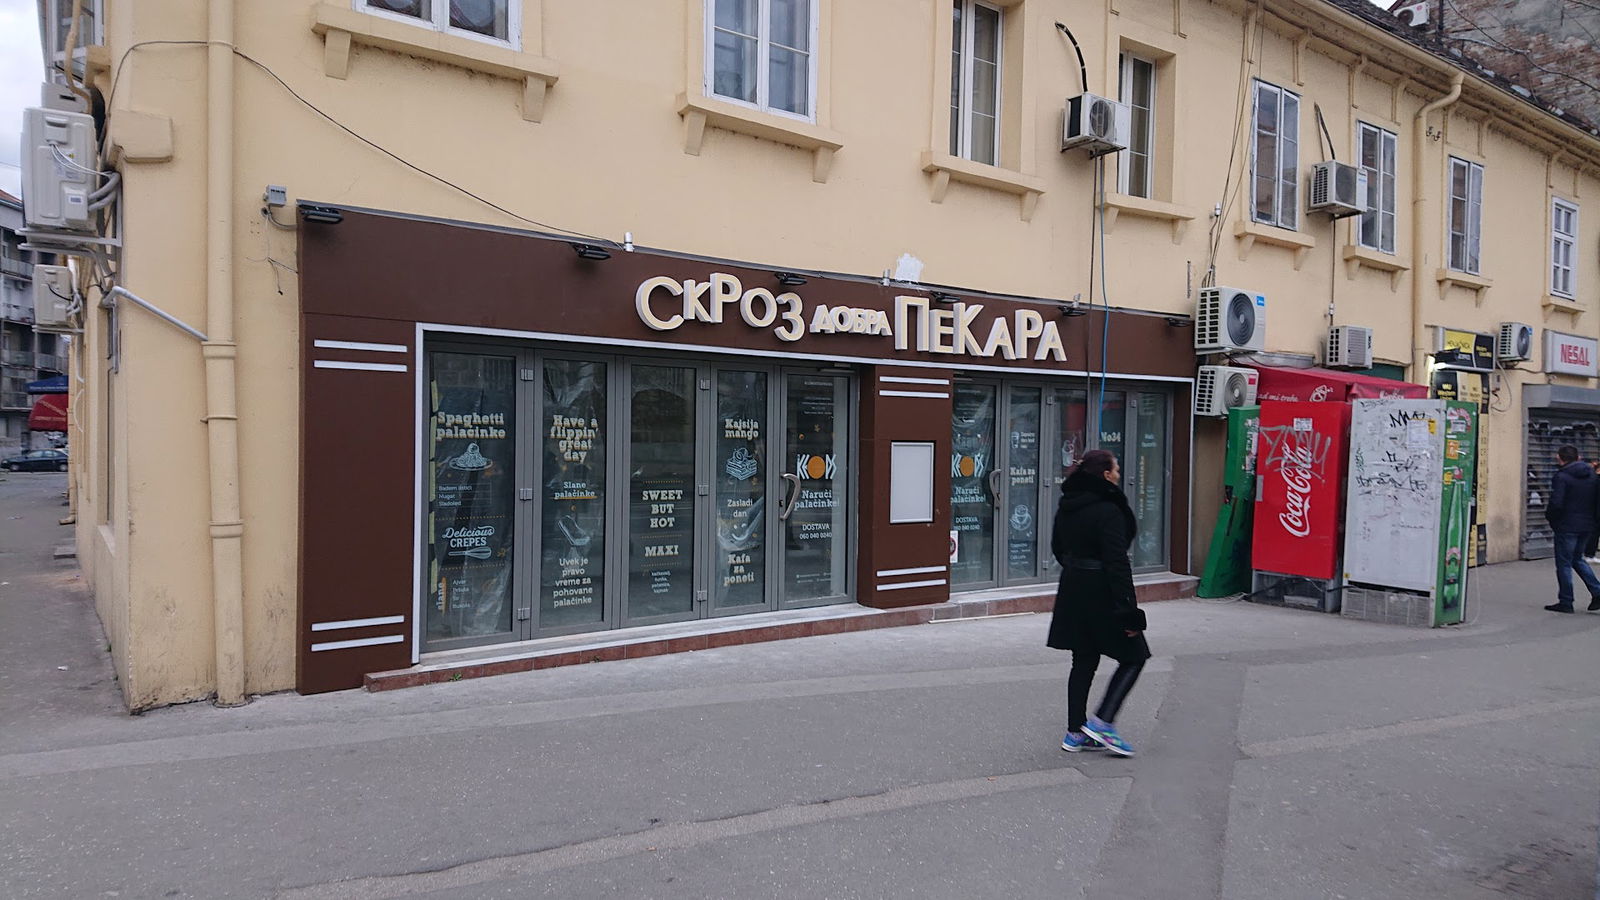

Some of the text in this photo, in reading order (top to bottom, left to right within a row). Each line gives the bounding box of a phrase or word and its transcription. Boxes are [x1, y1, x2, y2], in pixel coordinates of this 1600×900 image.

[636, 273, 1067, 362] СКРОЗ ДОБРА ПЕКАРА
[437, 412, 504, 428] Spaghetti
[553, 415, 598, 428] Have a
[725, 419, 759, 431] Kajsija
[725, 429, 759, 441] mango
[559, 438, 593, 453] great
[564, 450, 587, 464] day
[563, 481, 587, 489] Slane
[1011, 476, 1034, 486] poneti
[554, 489, 596, 500] palačinke
[642, 490, 683, 501] SWEET
[651, 503, 675, 514] BUT
[727, 498, 753, 508] Zasladi
[733, 509, 748, 518] dan
[650, 517, 675, 528] HOT
[802, 522, 830, 531] DOSTAVA
[442, 525, 495, 539] Delicious
[450, 537, 487, 548] CREPES
[645, 545, 679, 557] MAXI
[559, 556, 589, 567] Uvek je
[727, 554, 751, 565] Kafa
[562, 568, 585, 578] pravo
[733, 565, 745, 574] za
[555, 577, 592, 587] vreme za
[724, 572, 755, 587] poneti
[553, 587, 593, 599] pohovane
